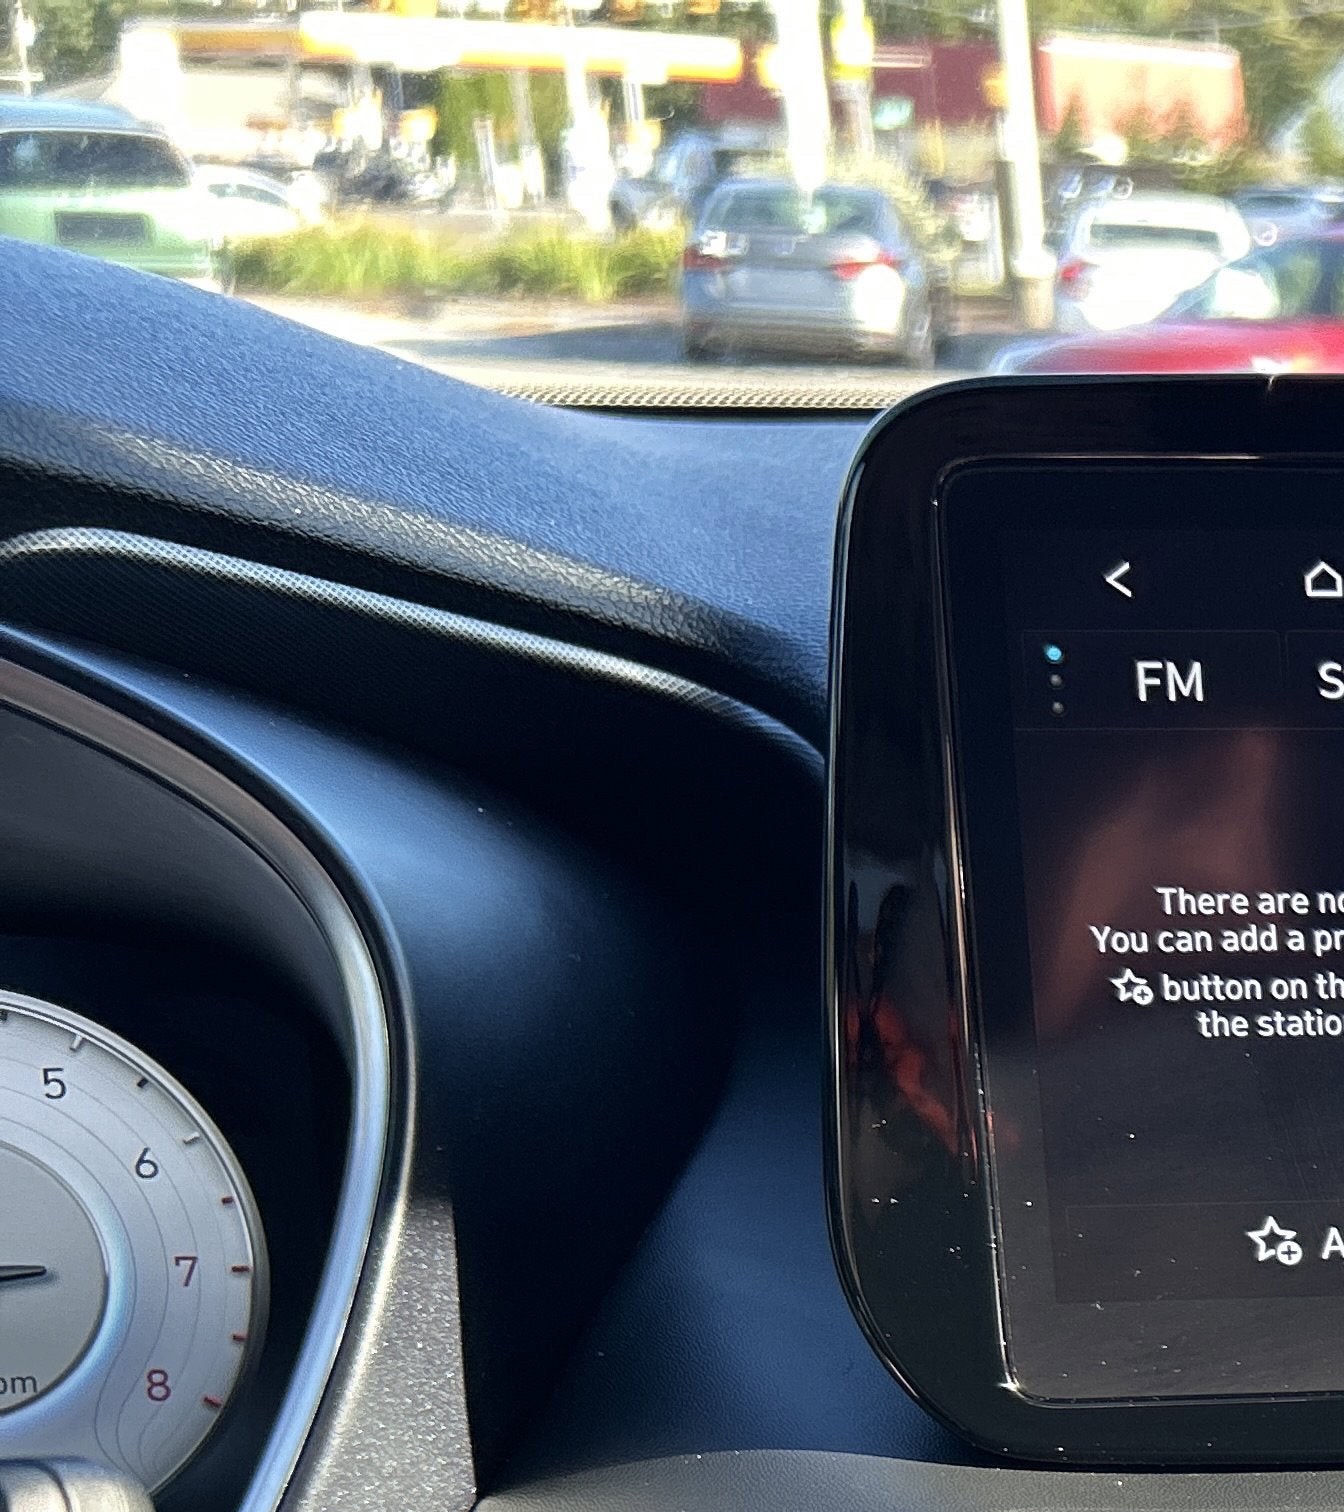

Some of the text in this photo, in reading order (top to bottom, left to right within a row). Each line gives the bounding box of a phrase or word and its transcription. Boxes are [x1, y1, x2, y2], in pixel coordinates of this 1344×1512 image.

[1135, 659, 1205, 703] FM
[1155, 886, 1250, 916] There
[1256, 892, 1310, 916] are
[1090, 925, 1150, 954] You
[1156, 930, 1213, 954] can
[1220, 923, 1279, 953] add
[1285, 929, 1306, 952] a
[1161, 972, 1262, 1002] button
[1269, 977, 1308, 1001] on
[1195, 1008, 1250, 1039] the
[41, 1067, 67, 1100] 5
[134, 1146, 160, 1179] 6
[174, 1256, 199, 1287] 7
[146, 1368, 172, 1402] 8
